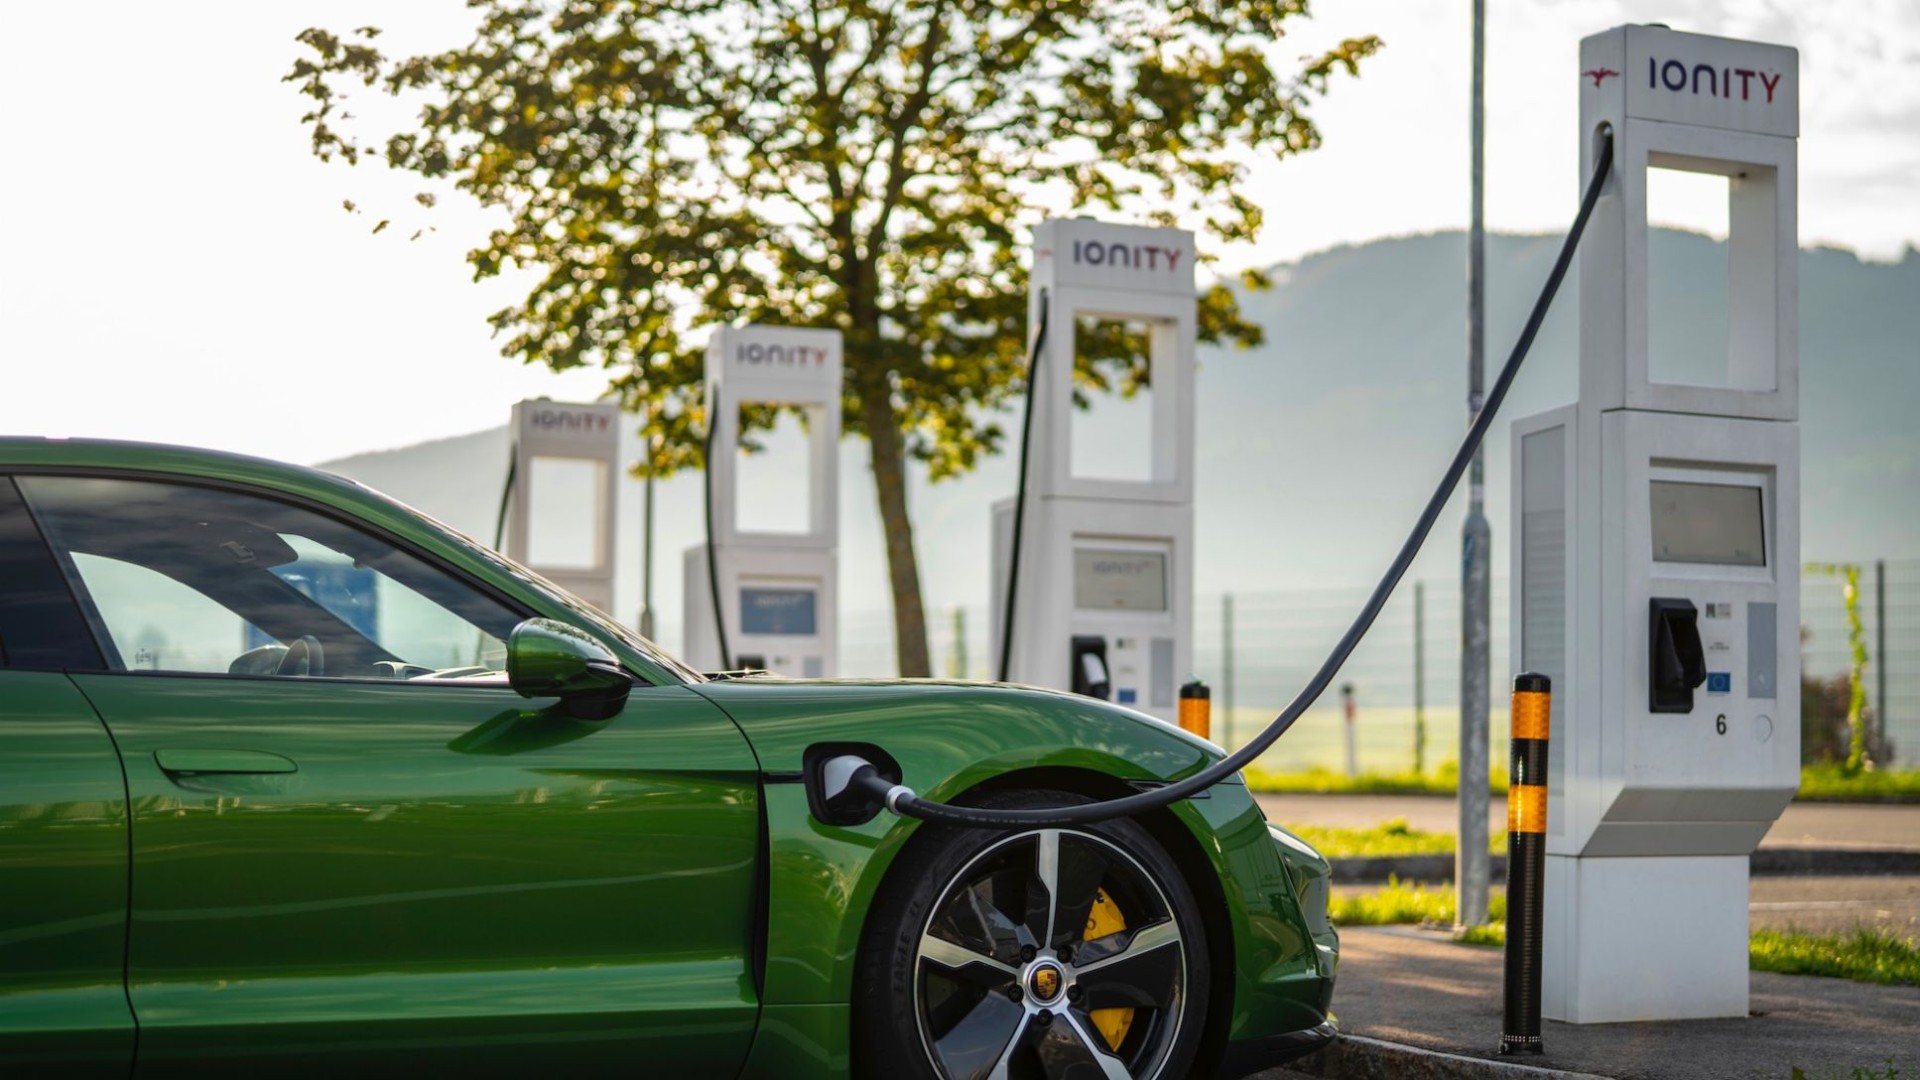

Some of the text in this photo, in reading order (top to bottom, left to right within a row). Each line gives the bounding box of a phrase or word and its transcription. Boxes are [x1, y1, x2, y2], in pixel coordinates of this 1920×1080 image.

[1649, 56, 1781, 104] IONITY
[1074, 240, 1181, 272] IONITY
[736, 342, 828, 366] IONITY
[1716, 713, 1727, 736] 6
